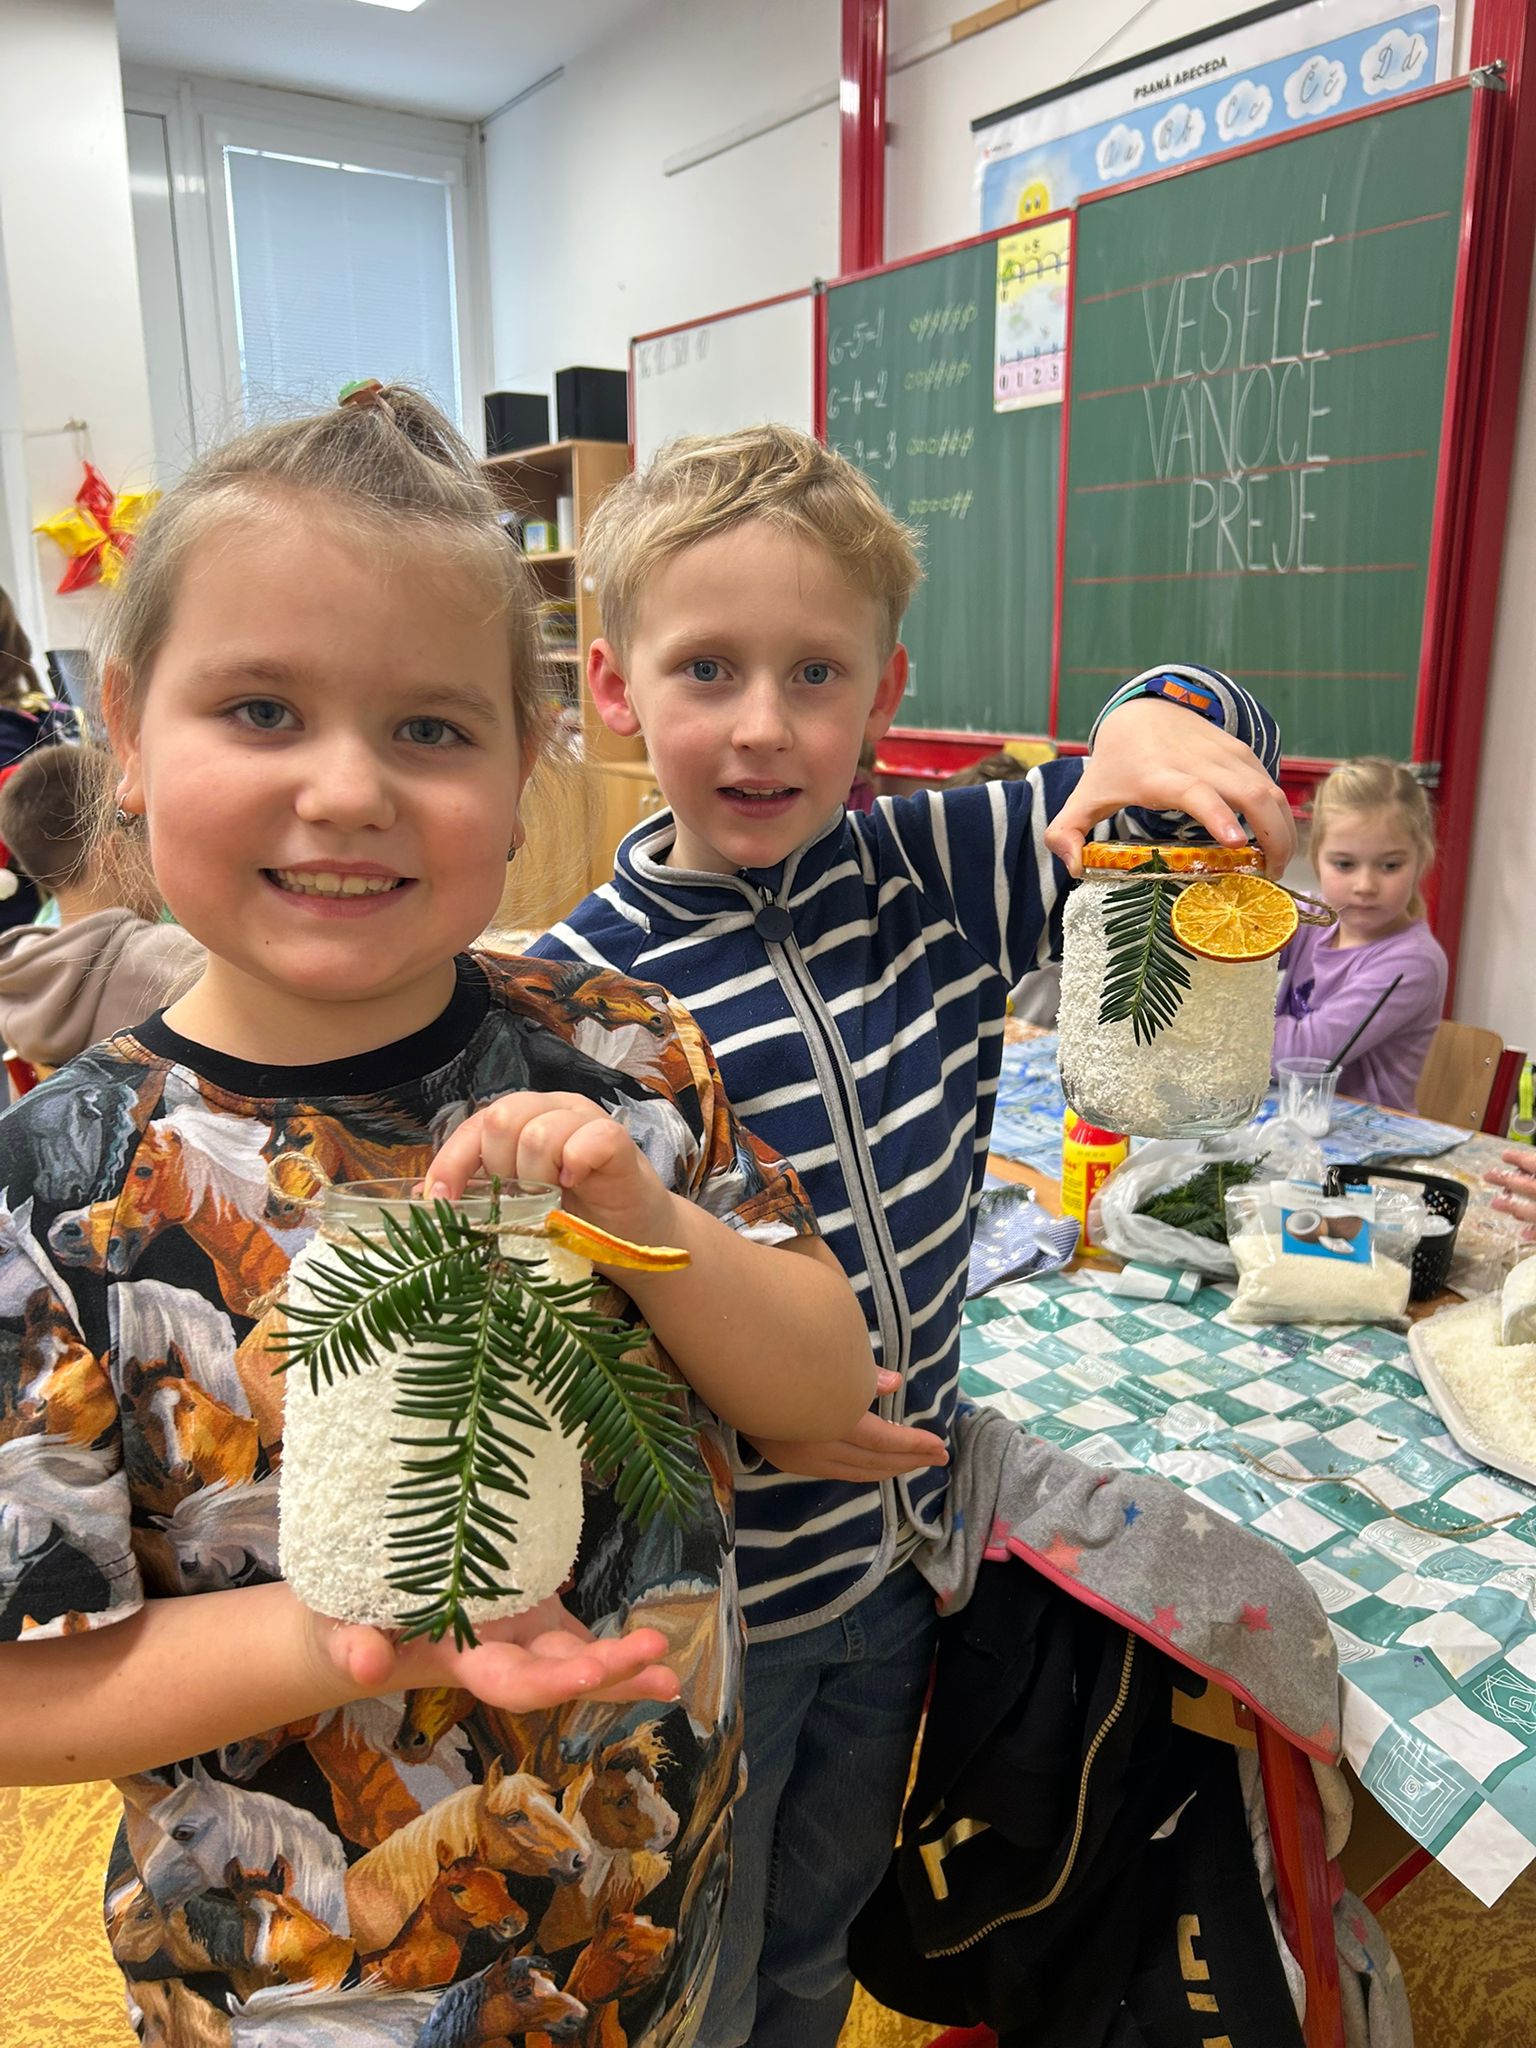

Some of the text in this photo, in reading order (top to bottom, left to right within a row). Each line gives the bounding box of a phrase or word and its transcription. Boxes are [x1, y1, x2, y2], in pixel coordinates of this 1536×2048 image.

[1134, 55, 1229, 101] PSANÁ ABECEDA
[1141, 193, 1335, 384] VESELÉ
[1143, 356, 1331, 481] VÁNOCE
